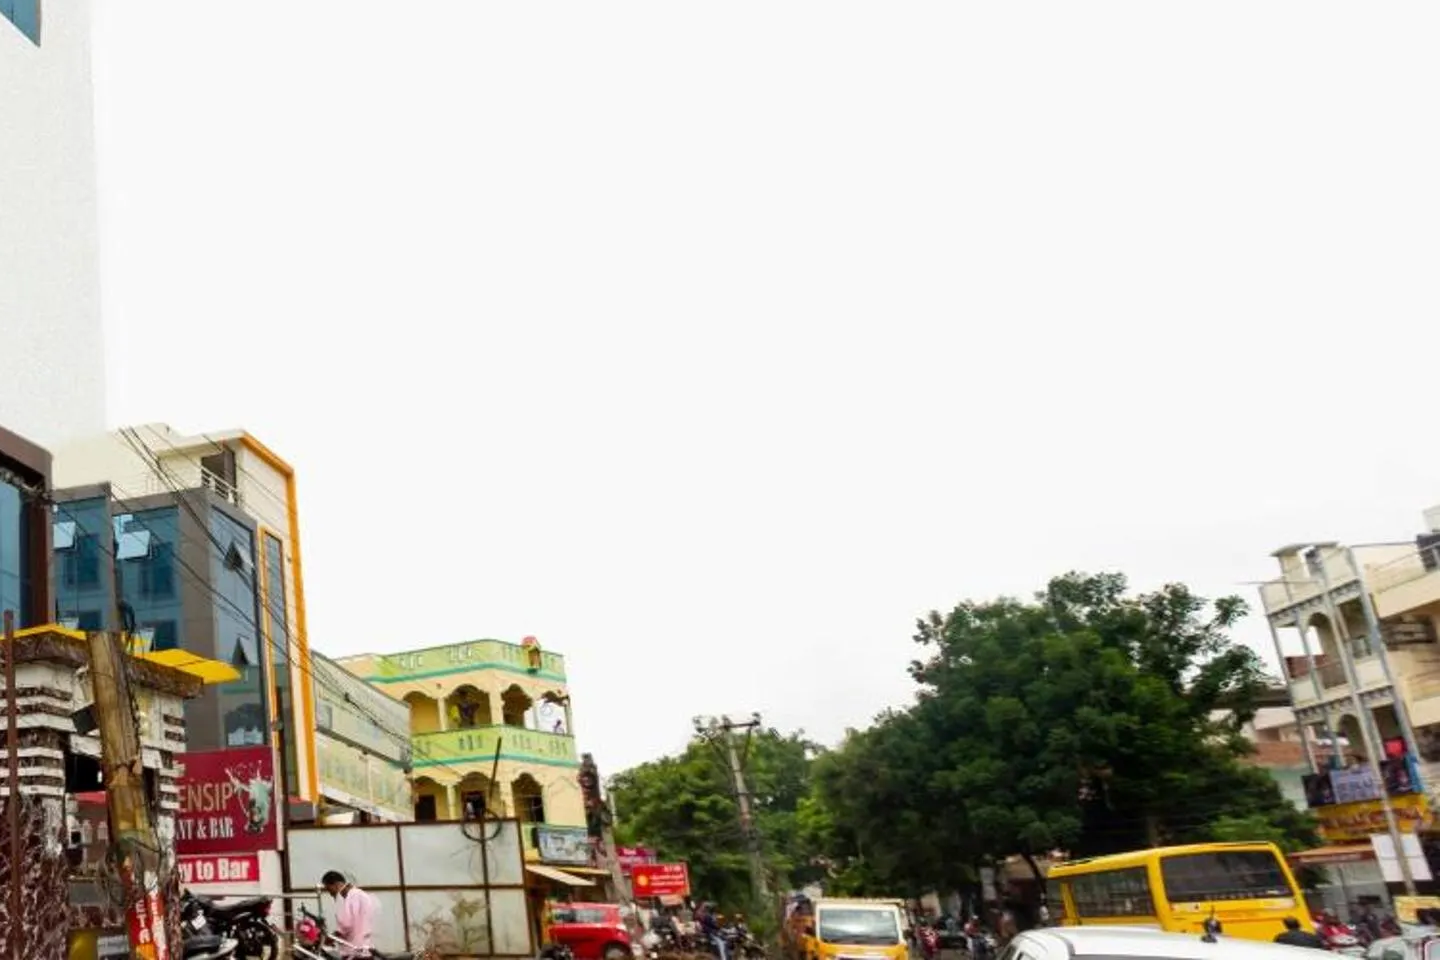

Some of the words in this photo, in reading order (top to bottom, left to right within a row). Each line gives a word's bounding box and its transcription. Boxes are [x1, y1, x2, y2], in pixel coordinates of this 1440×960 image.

[209, 816, 234, 839] BAR
[196, 859, 214, 880] to
[217, 857, 251, 881] Bar
